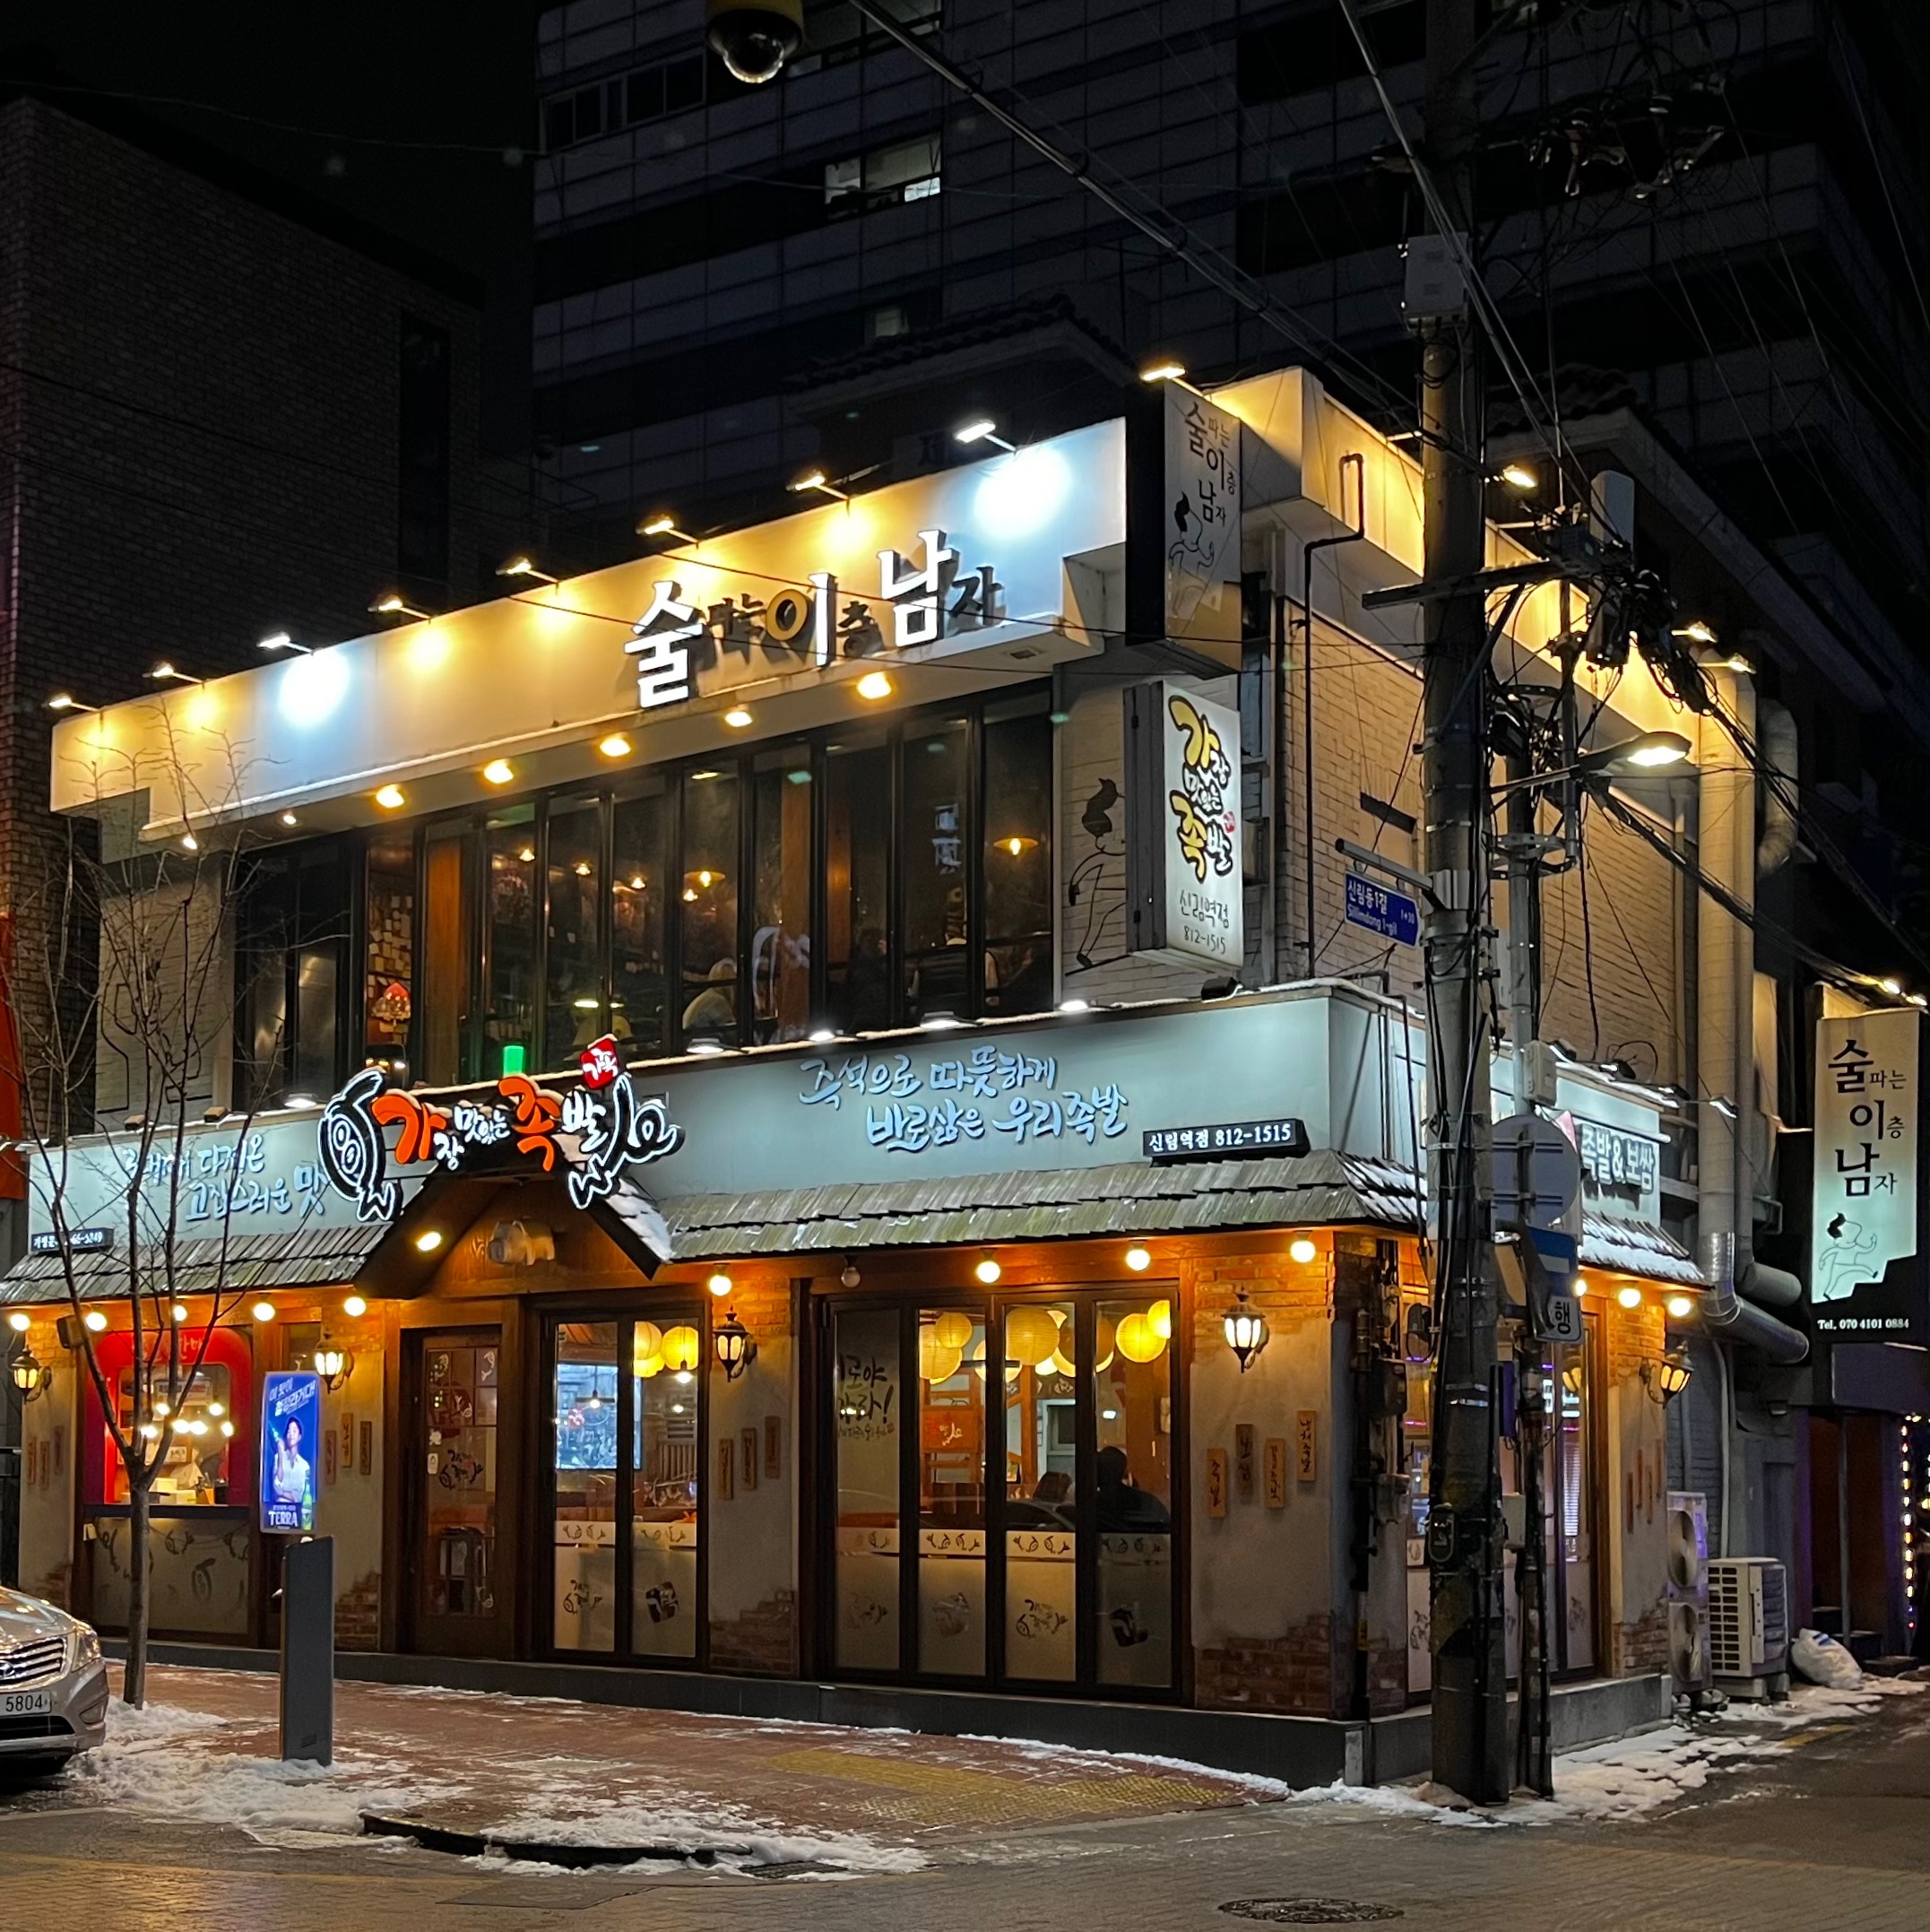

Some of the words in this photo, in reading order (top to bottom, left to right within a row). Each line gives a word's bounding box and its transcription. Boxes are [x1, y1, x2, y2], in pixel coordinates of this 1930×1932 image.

[1180, 888, 1229, 929] 신림역점
[1183, 924, 1226, 956] 812-1515
[799, 1053, 922, 1110] 즉석으로
[930, 1045, 1057, 1098] 따뜻하게
[371, 1091, 467, 1171] 가장
[496, 1076, 609, 1173] 족발
[1149, 1130, 1208, 1152] 신림역점
[1215, 1123, 1291, 1147] 812-1515
[186, 1177, 293, 1222] 고집스러운
[294, 1165, 331, 1217] 맛
[1817, 1319, 1838, 1330] Tel.
[1839, 1319, 1858, 1330] 070
[1859, 1319, 1882, 1330] 4101
[268, 1511, 298, 1528] TERRA
[5, 1694, 43, 1712] 5804
